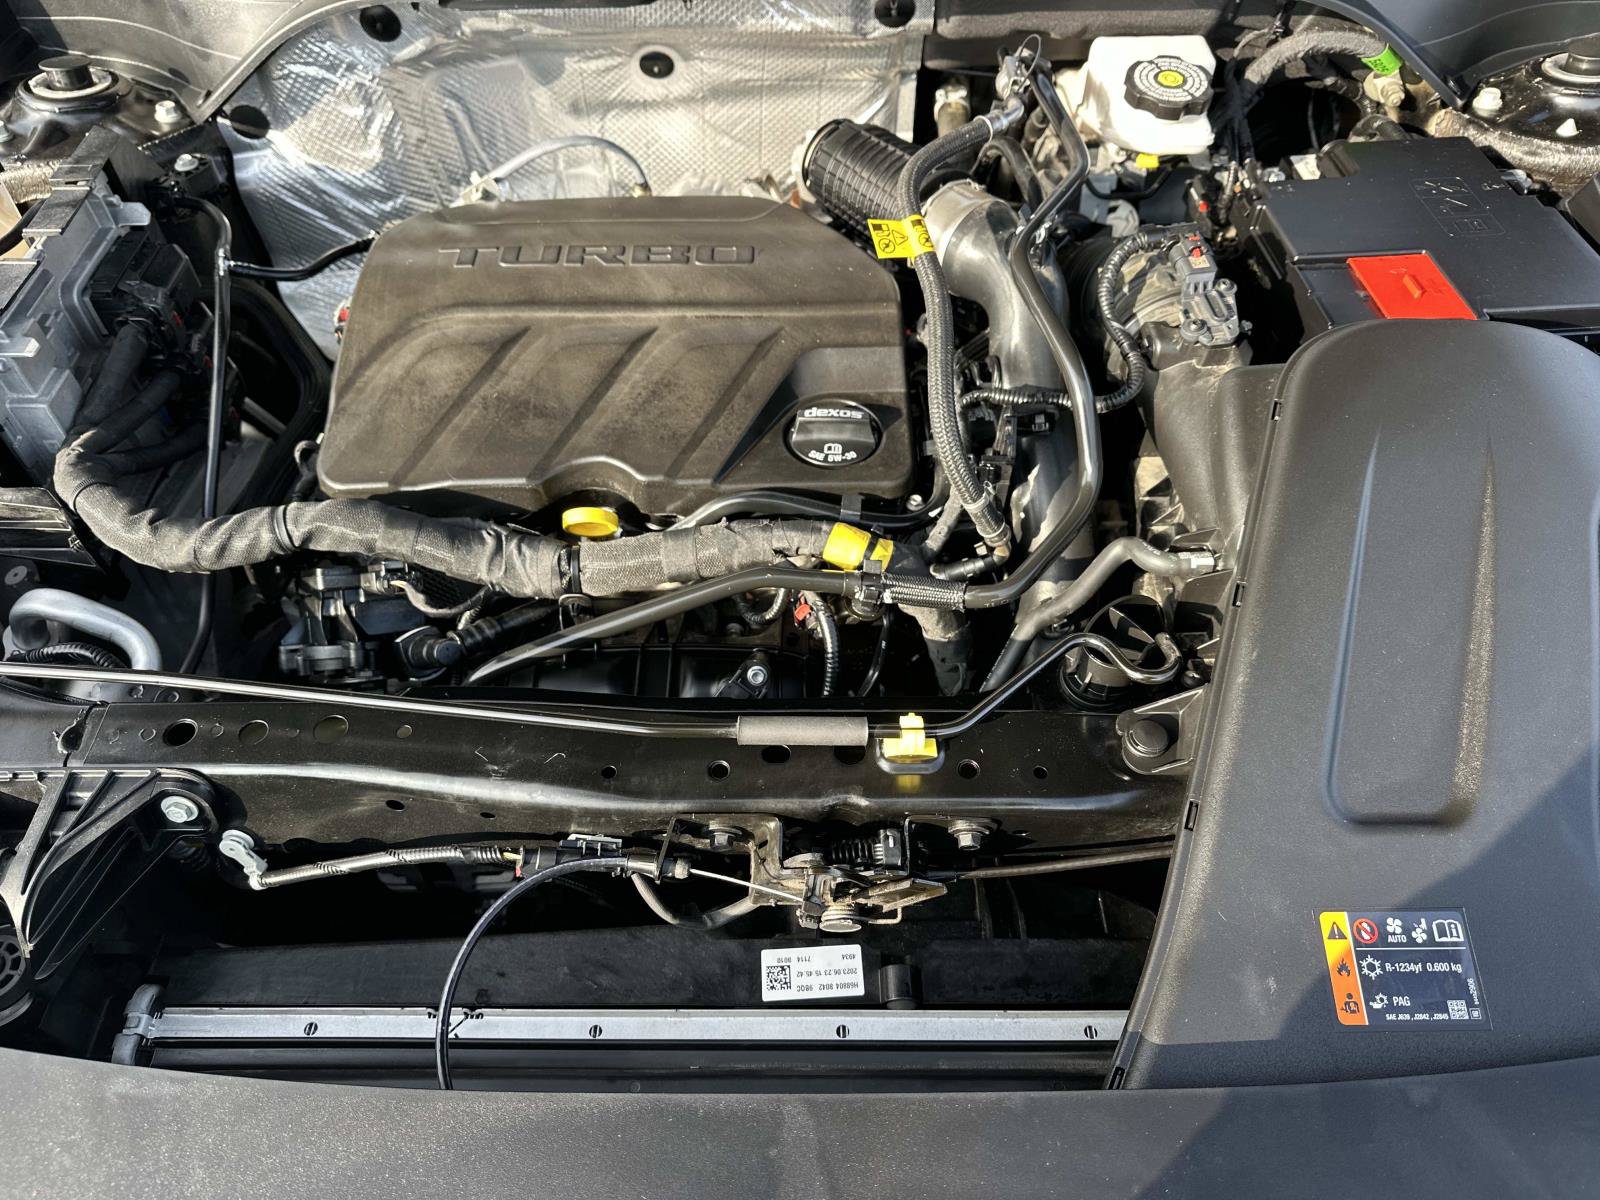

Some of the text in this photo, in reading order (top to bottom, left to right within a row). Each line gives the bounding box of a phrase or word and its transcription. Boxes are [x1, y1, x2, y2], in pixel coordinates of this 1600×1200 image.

[438, 245, 755, 267] TURBO
[804, 407, 864, 419] dexos
[1387, 934, 1407, 943] AUTO
[1385, 962, 1462, 974] R-1234yf 0.600 kg
[1392, 996, 1411, 1007] PAG
